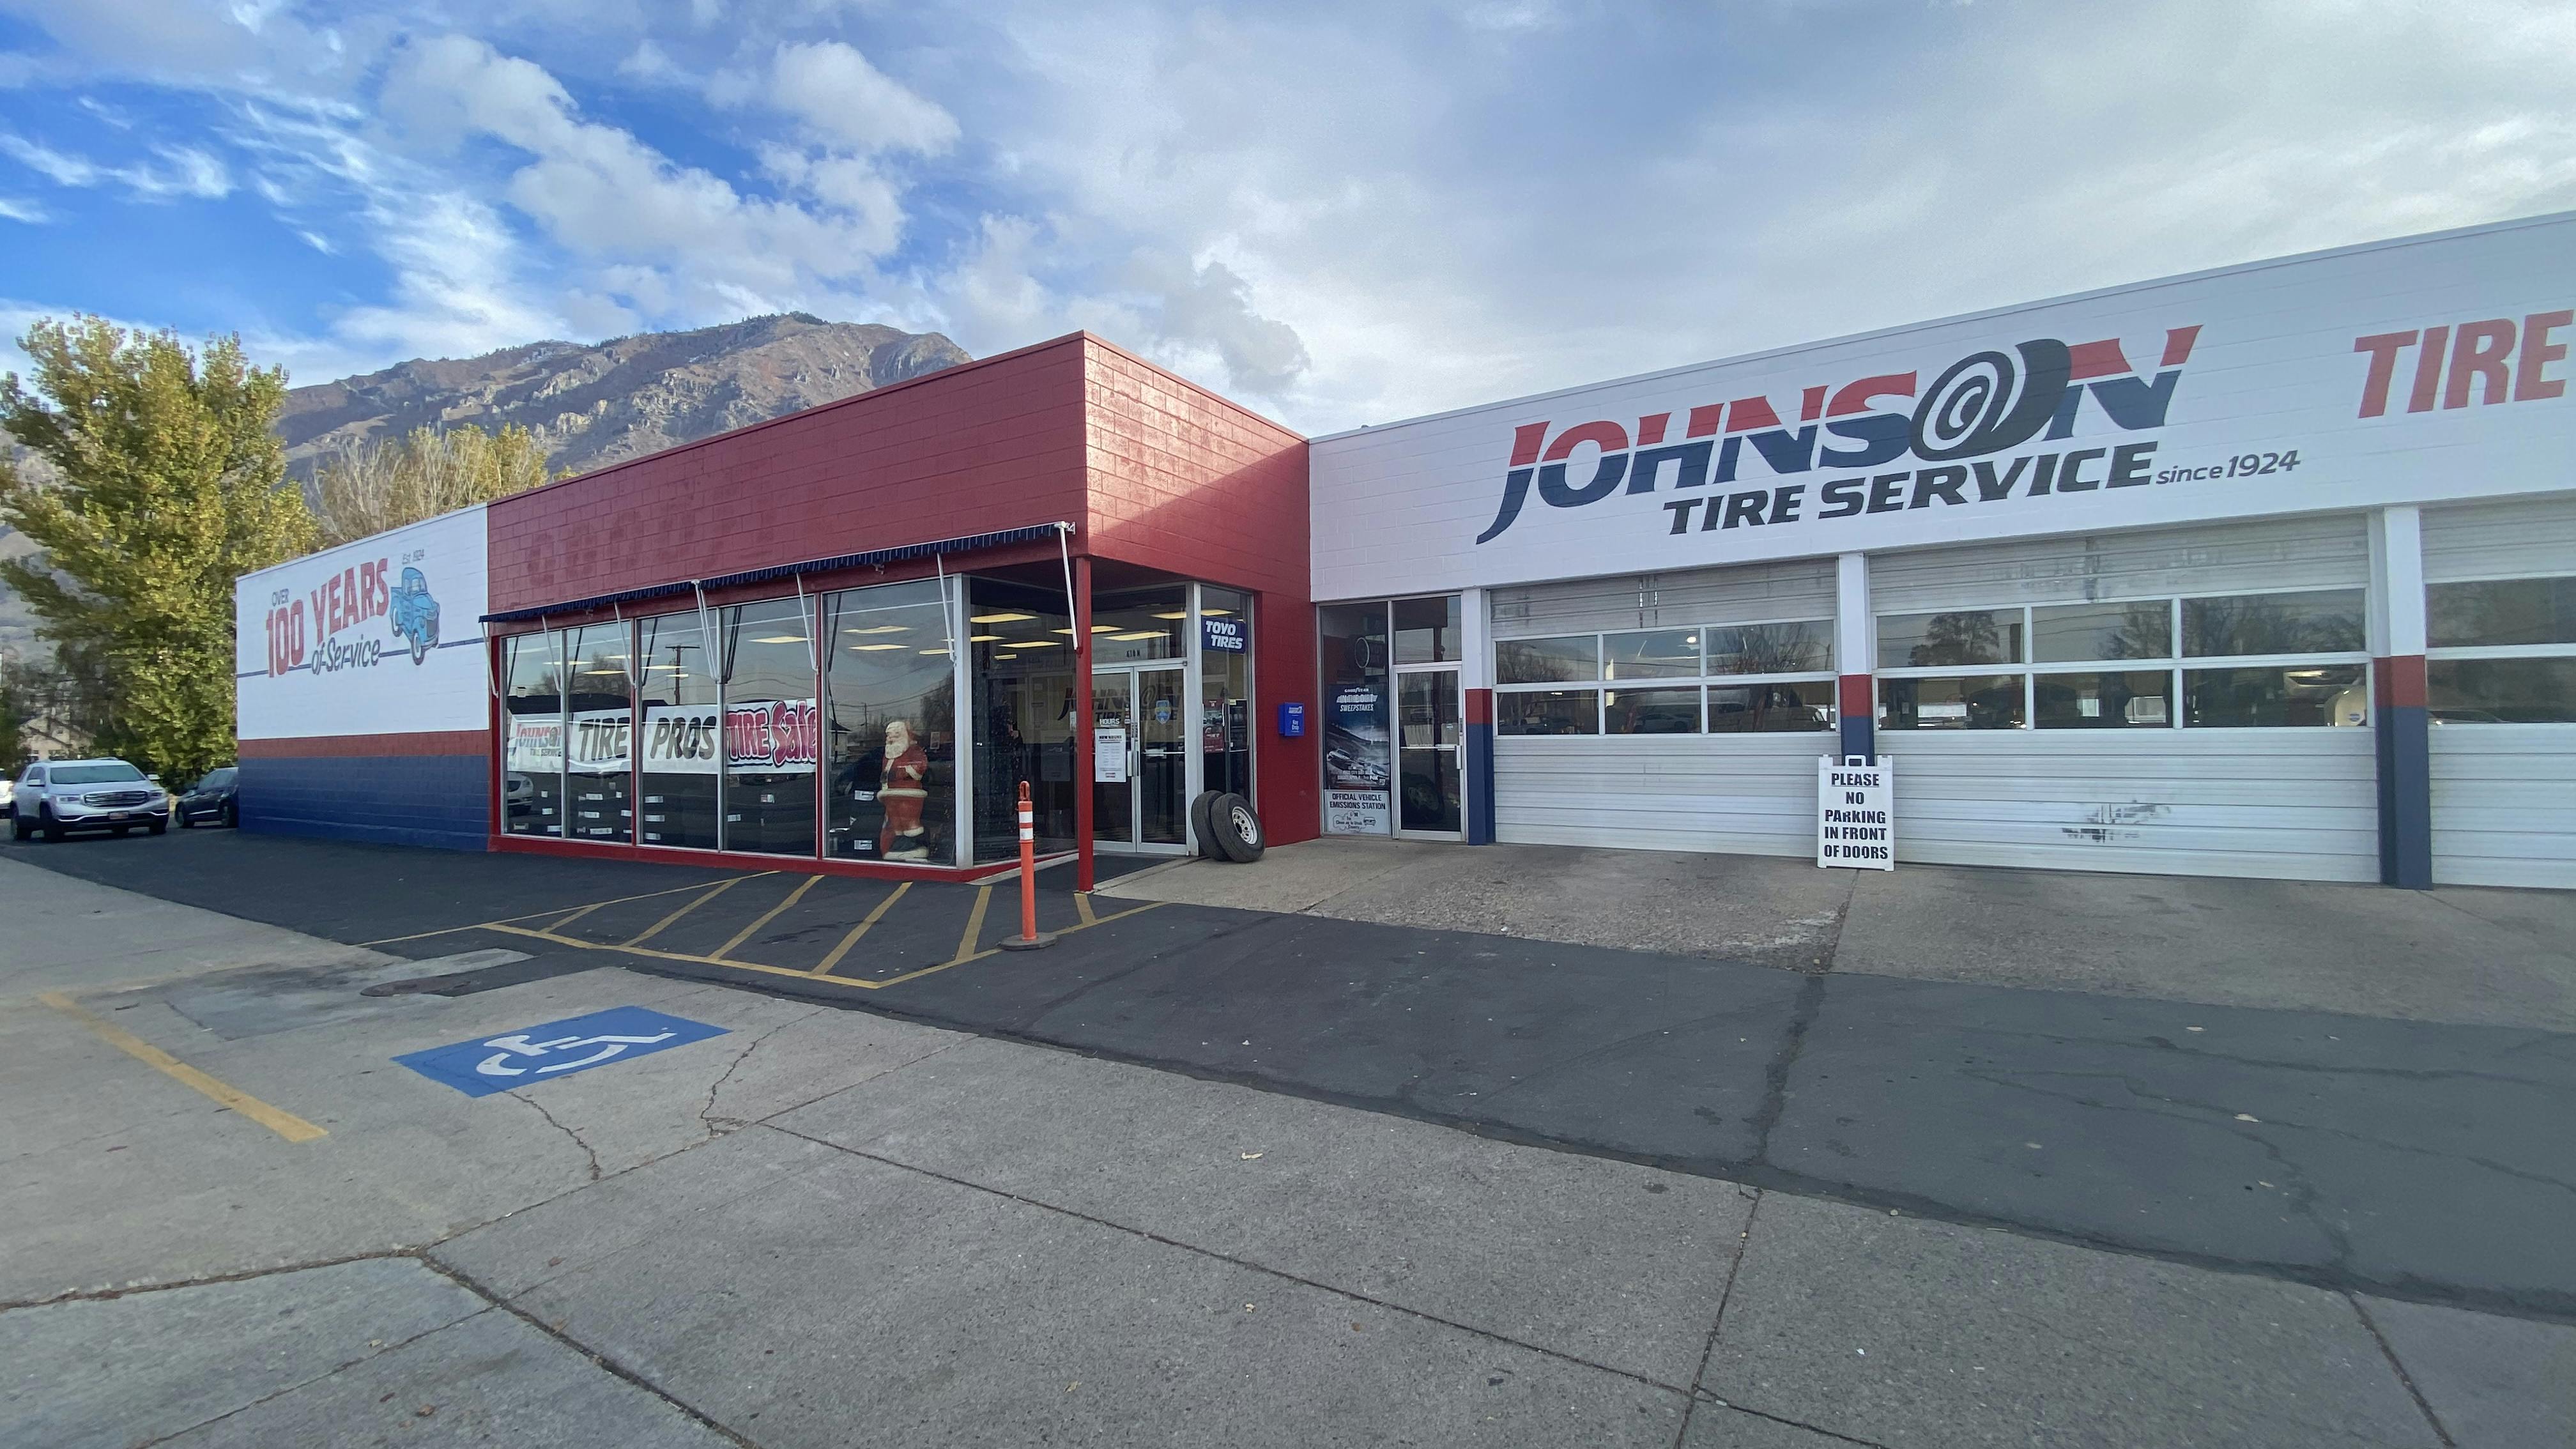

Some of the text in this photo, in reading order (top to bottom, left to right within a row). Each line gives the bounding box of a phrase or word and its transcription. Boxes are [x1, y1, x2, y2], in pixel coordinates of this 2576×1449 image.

[2354, 309, 2574, 418] TIRE
[1476, 324, 2203, 544] JOHNSON
[2156, 449, 2301, 486] since 1924
[1663, 440, 2160, 535] TIRE SERVICE
[272, 588, 289, 606] OVER
[266, 558, 389, 678] 100 YEARS
[1206, 620, 1236, 636] TOYO
[312, 634, 381, 675] of Service
[1211, 634, 1243, 649] TIRES
[1340, 703, 1374, 712] SWEEPSTAKES
[578, 716, 631, 762] TIRE
[649, 716, 717, 760] PROS
[726, 709, 770, 761] TIRE
[1831, 773, 1880, 786] PLEASE
[1846, 792, 1864, 804] NO
[1825, 809, 1886, 824] PARKING
[1825, 827, 1887, 840] IN FRONT
[1824, 845, 1889, 859] OF DOORS
